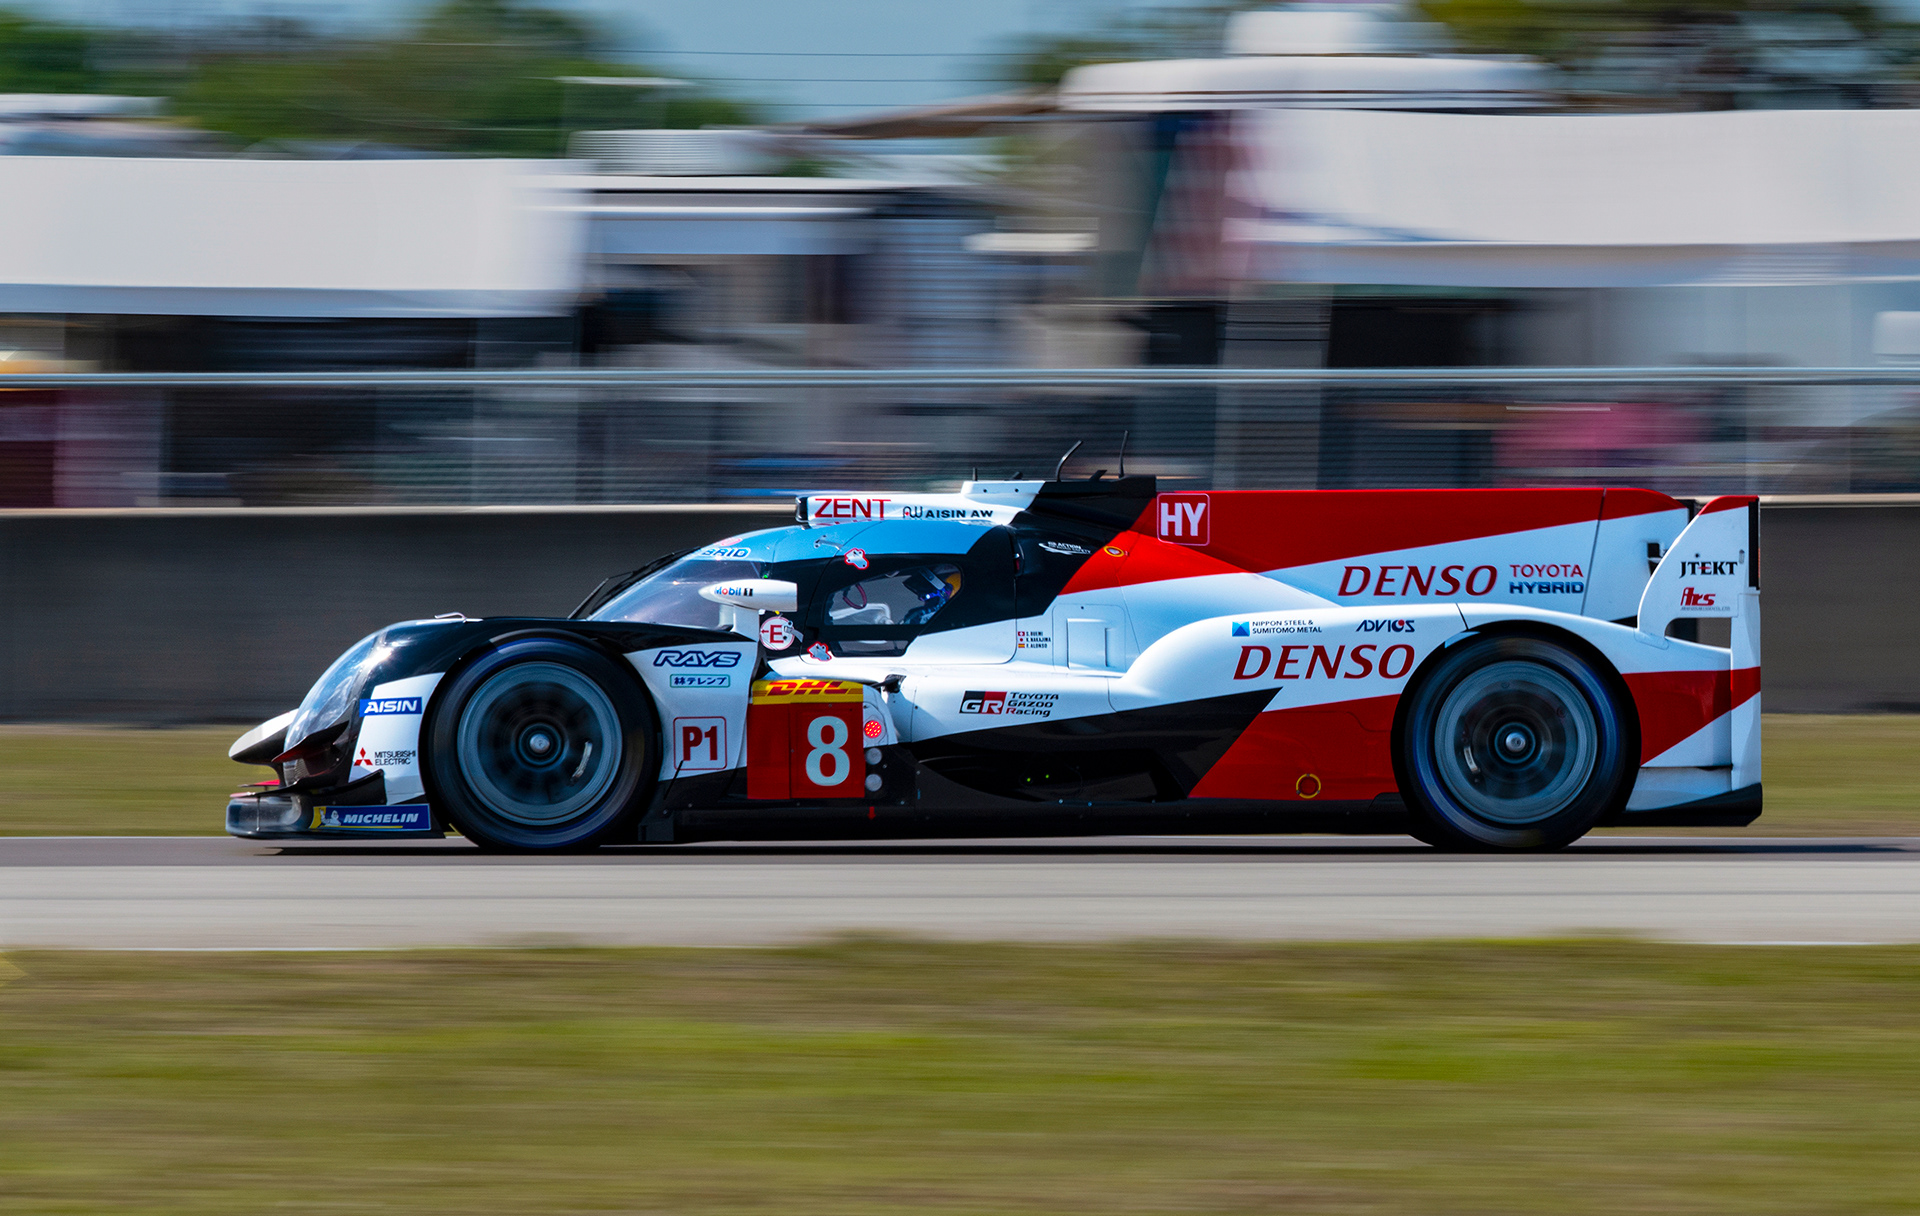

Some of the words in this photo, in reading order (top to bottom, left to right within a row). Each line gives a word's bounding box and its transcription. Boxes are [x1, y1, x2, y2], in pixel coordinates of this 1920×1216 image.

[815, 498, 891, 518] ZENT
[925, 509, 966, 518] AISIN
[970, 510, 993, 518] AW
[1160, 502, 1207, 536] HY
[1509, 564, 1584, 578] TOYOTA
[1679, 561, 1738, 579] JTEKT
[1337, 565, 1498, 596] DENSO
[1509, 581, 1584, 594] HYBRID
[714, 586, 741, 596] Mobil
[769, 624, 784, 643] E
[653, 650, 742, 667] RAYS
[1233, 644, 1415, 680] DENSO
[766, 681, 849, 696] DHL
[1010, 691, 1059, 700] TOYOTA
[364, 700, 418, 713] AISIN
[961, 699, 1004, 715] GR
[1007, 700, 1054, 708] GAZOO
[1005, 708, 1051, 718] Racing
[682, 725, 718, 761] P1
[374, 750, 416, 759] MITSUBISHI
[805, 715, 851, 787] 8
[374, 758, 411, 766] ELECTRIC
[343, 813, 419, 824] MICHELIN
